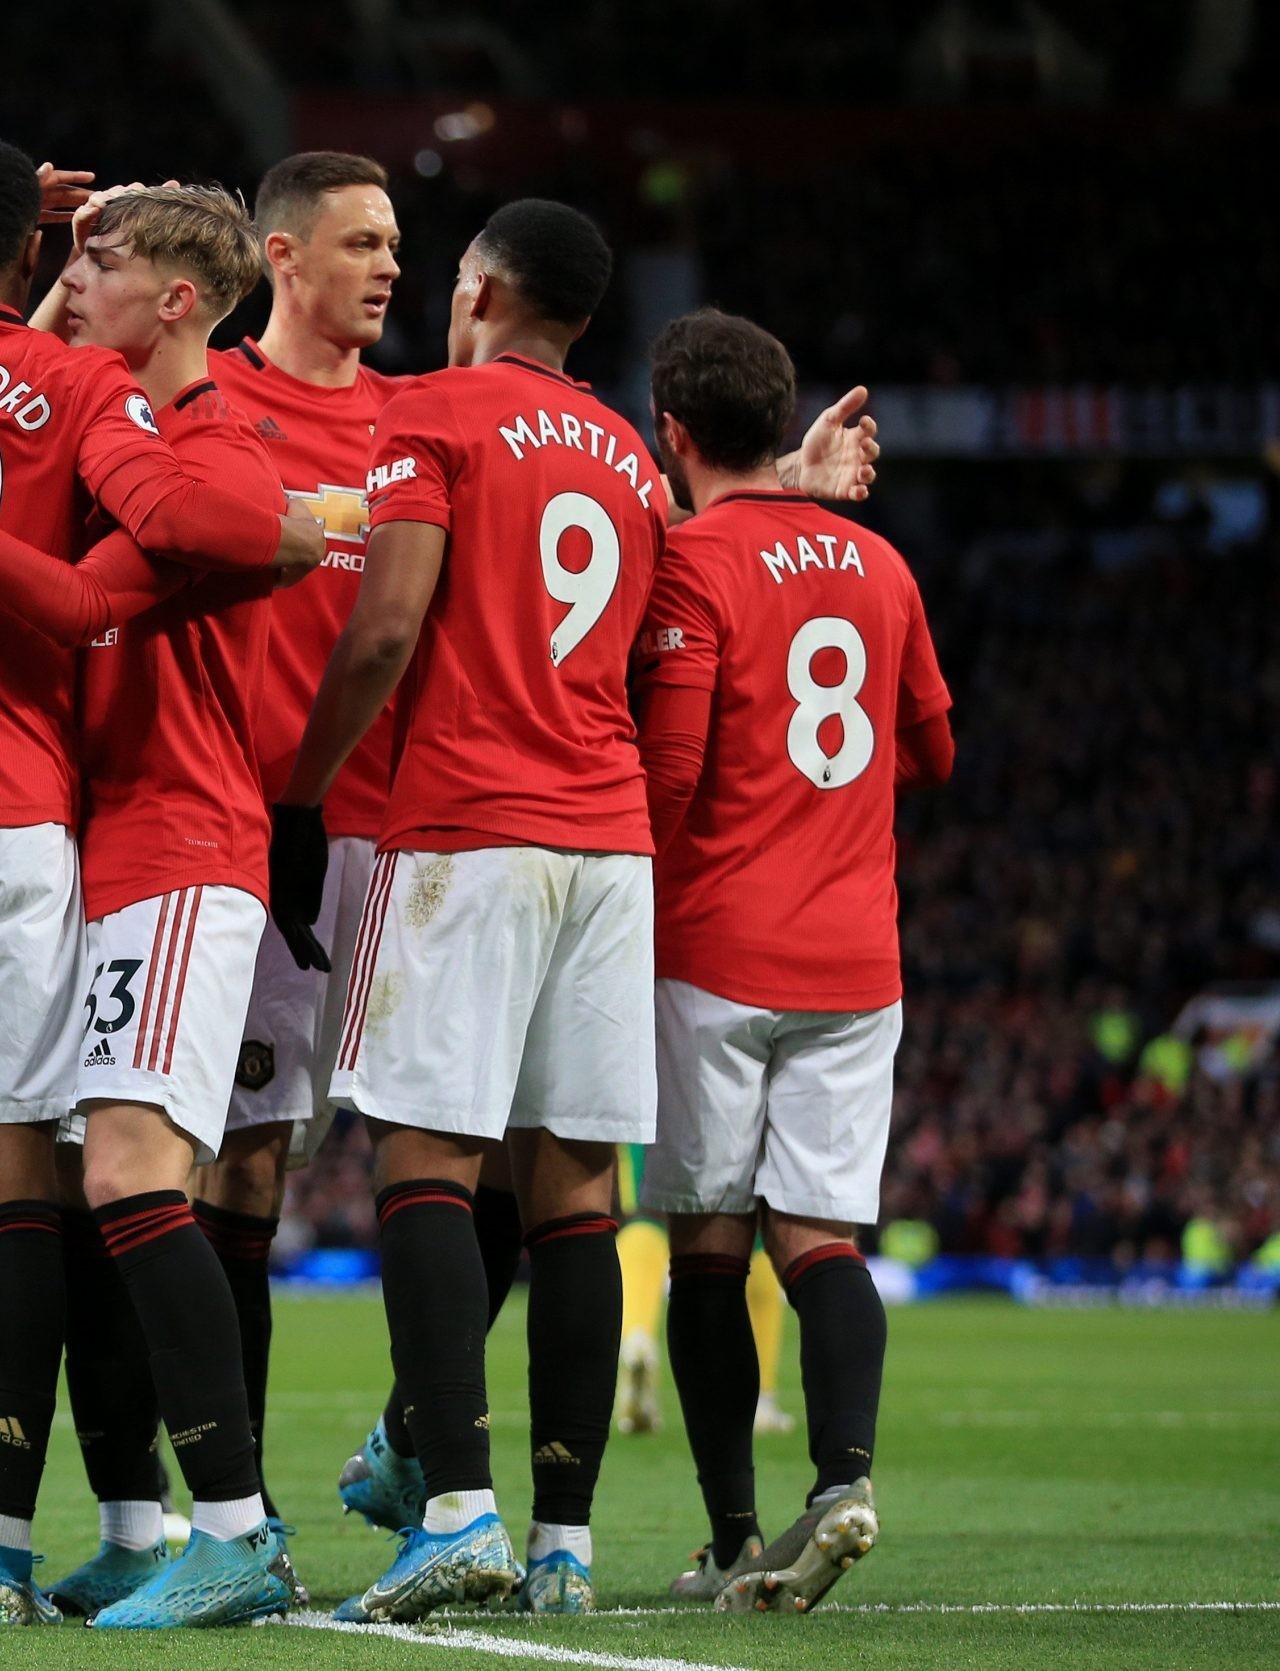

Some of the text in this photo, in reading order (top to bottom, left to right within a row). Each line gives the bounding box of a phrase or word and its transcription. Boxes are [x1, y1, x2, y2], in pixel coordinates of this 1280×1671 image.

[499, 410, 653, 509] MARTIAL
[538, 491, 620, 668] 9
[760, 534, 865, 585] MATA
[786, 616, 876, 790] 8
[83, 1054, 116, 1068] adidas
